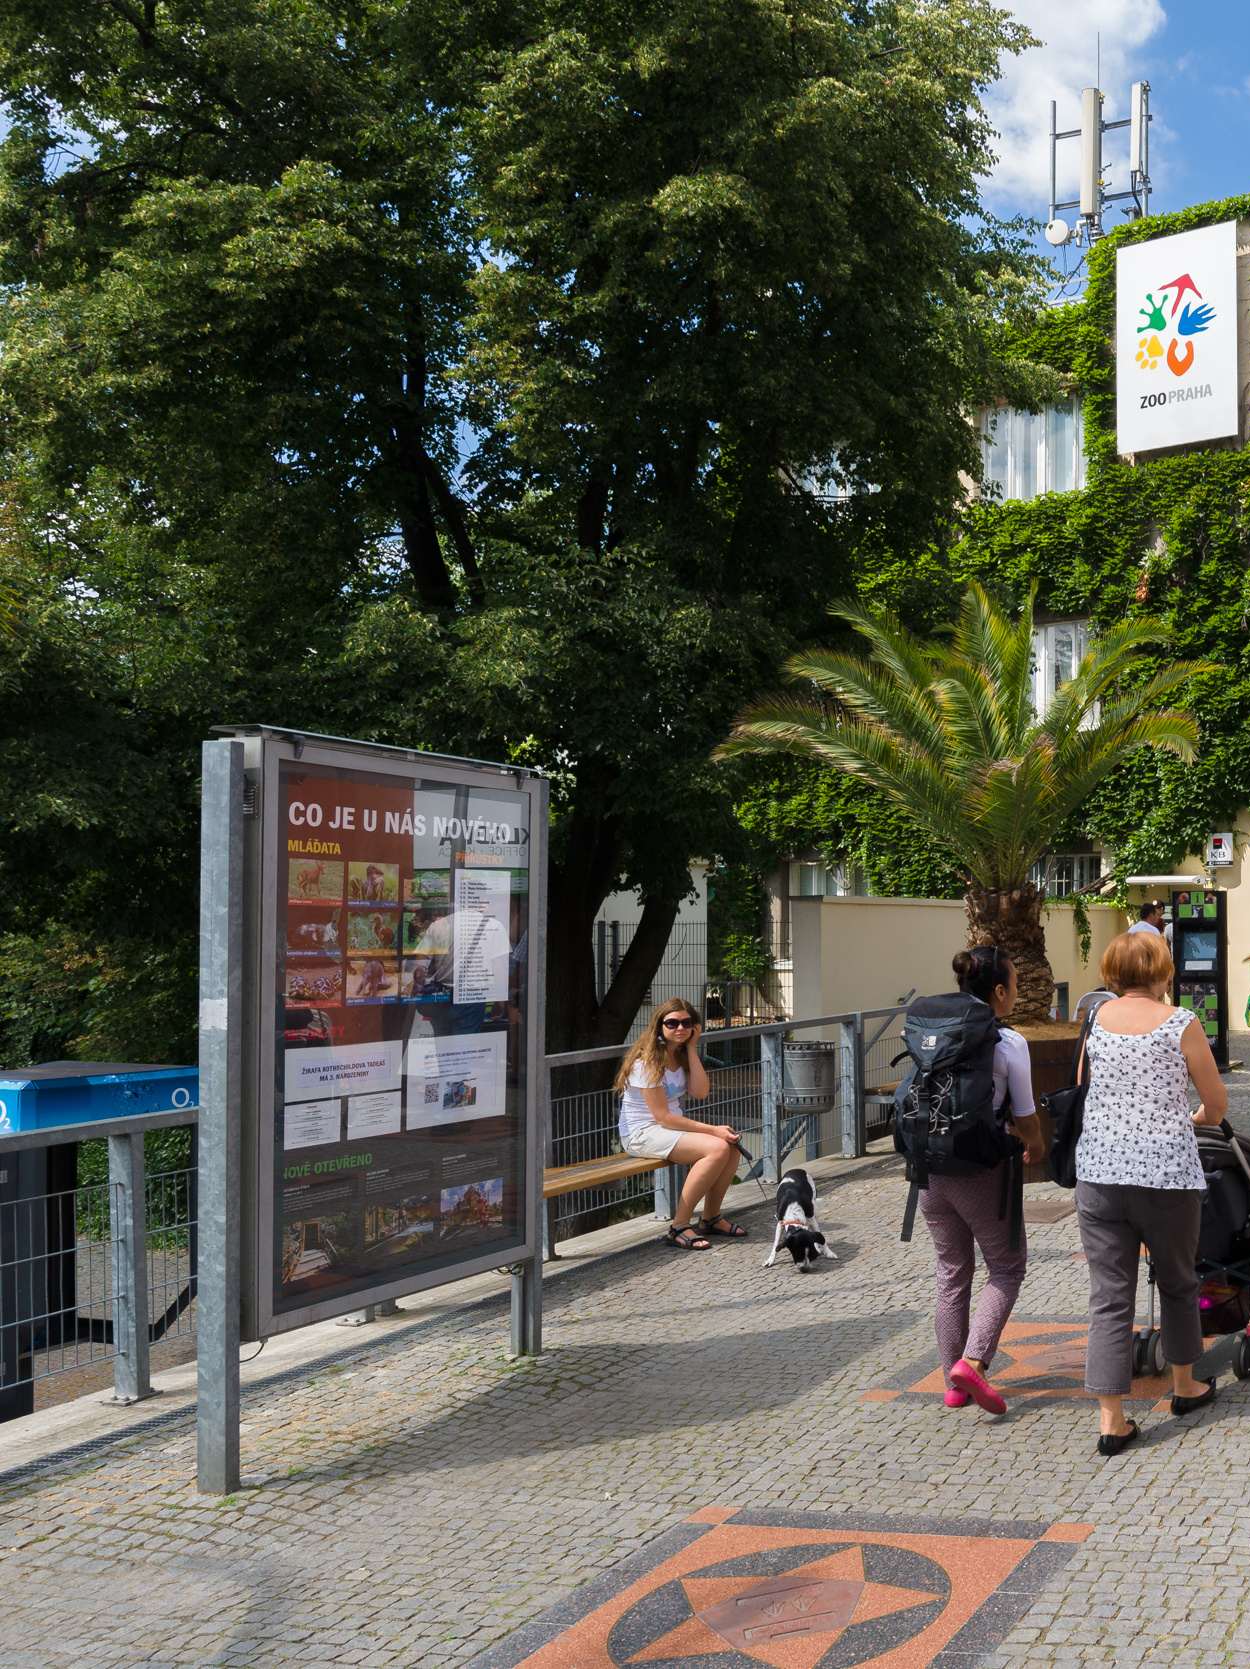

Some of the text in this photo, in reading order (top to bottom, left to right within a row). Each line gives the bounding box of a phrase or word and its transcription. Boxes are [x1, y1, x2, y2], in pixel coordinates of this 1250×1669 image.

[1140, 384, 1213, 409] ZOO PRAHA
[288, 801, 511, 844] CO JE U NÁS NOVÉHO
[287, 838, 341, 855] MLÁĎATA
[1210, 851, 1226, 859] KB
[314, 1153, 373, 1174] OTEVŘENO
